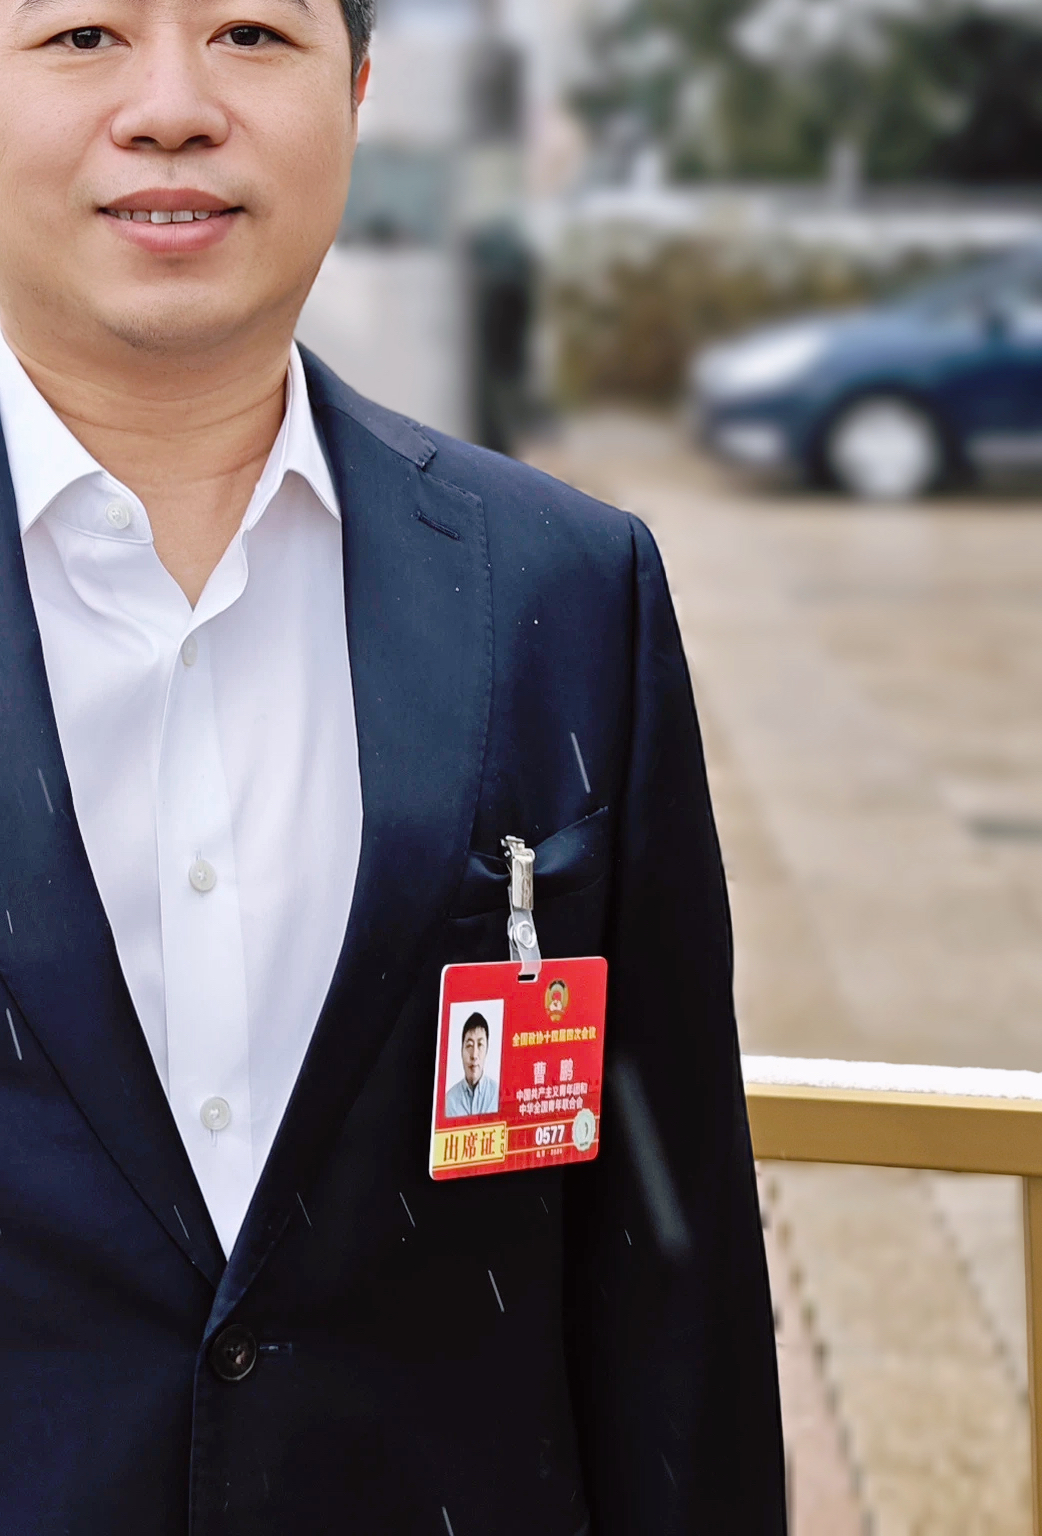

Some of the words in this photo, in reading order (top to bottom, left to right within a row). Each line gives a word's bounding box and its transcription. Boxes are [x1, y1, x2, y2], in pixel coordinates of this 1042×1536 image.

[443, 1130, 495, 1161] 出席证
[535, 1125, 565, 1146] 0577
